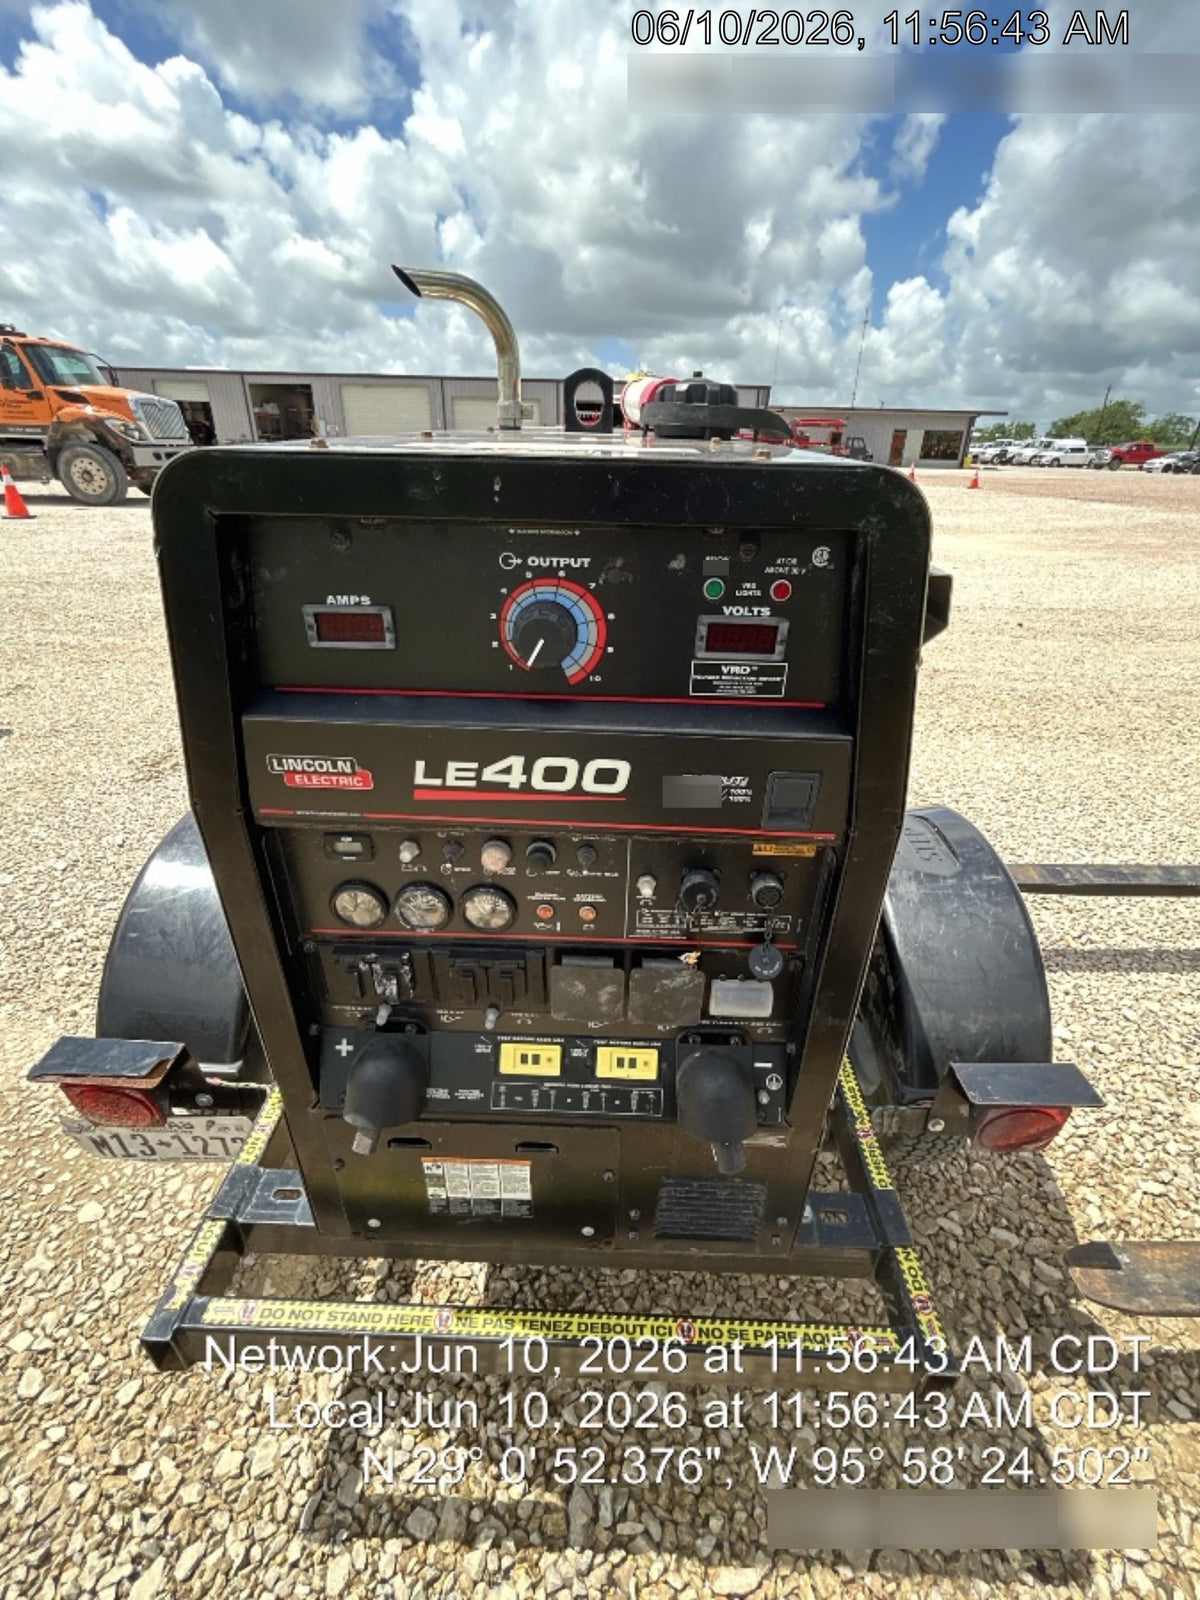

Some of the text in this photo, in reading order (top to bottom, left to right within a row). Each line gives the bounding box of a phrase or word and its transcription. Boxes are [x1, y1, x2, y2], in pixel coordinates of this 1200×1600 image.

[527, 556, 591, 568] OUTPUT
[326, 594, 372, 606] AMPS
[722, 605, 771, 617] VOLTS
[271, 758, 352, 774] LINCOLN
[294, 774, 364, 787] ELECTRIC
[413, 755, 632, 794] LE400
[259, 1307, 285, 1320] DO
[288, 1308, 322, 1322] NOT
[326, 1310, 383, 1325] STAND
[386, 1312, 434, 1327] HERE
[454, 1315, 479, 1329] NE
[482, 1317, 516, 1331] PAS
[518, 1318, 574, 1333] TENEZ
[576, 1320, 648, 1336] DEBOUT
[650, 1324, 674, 1338] ICI
[698, 1327, 724, 1340] NO
[726, 1327, 749, 1341] SE
[753, 1328, 798, 1344] PARE
